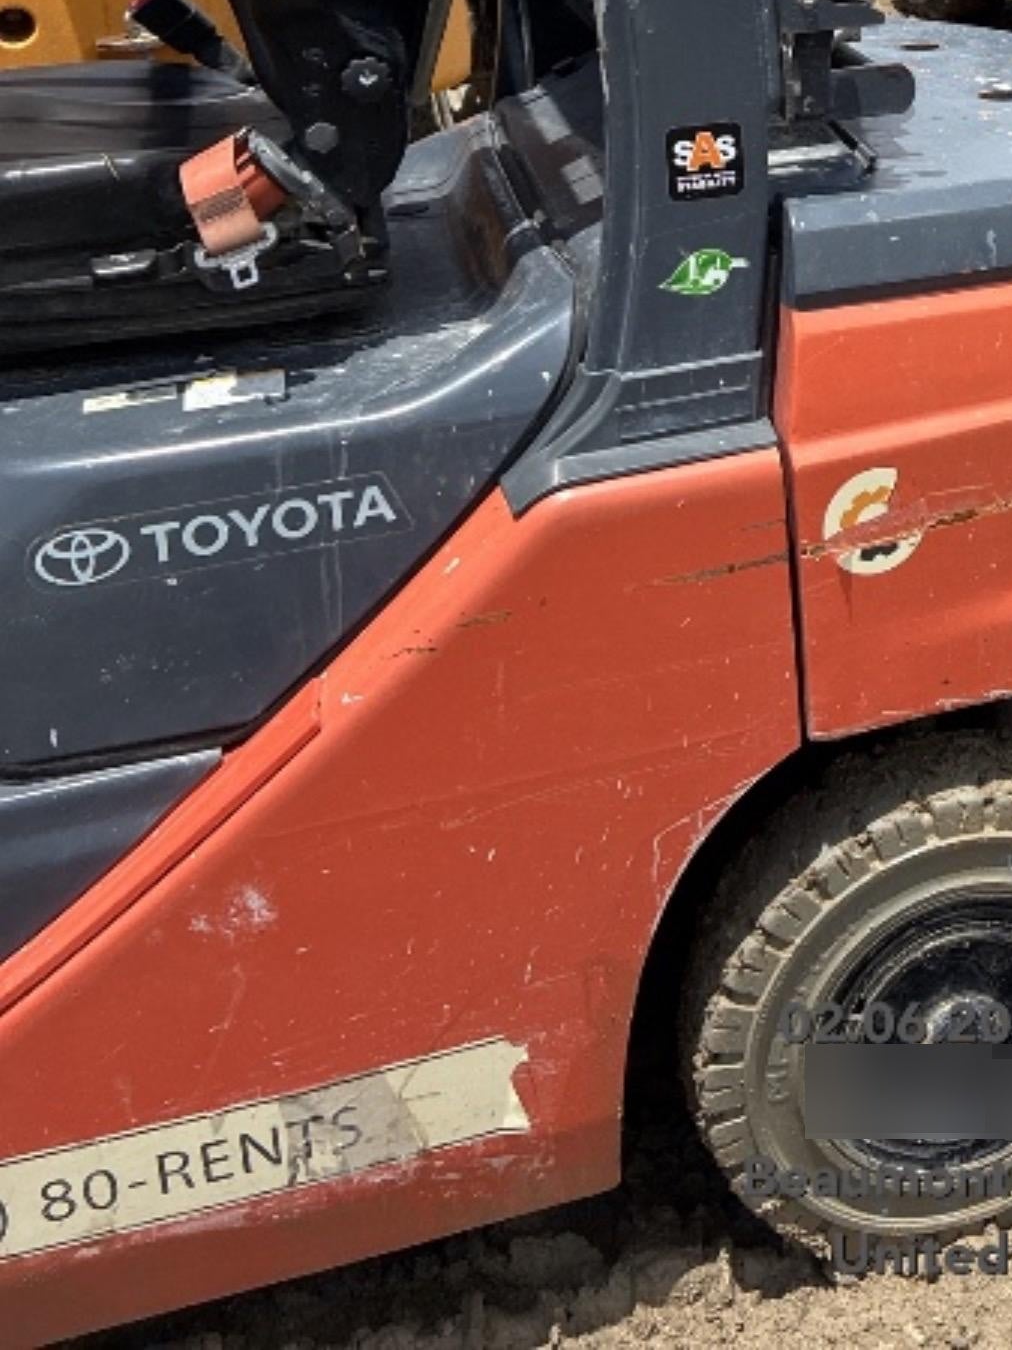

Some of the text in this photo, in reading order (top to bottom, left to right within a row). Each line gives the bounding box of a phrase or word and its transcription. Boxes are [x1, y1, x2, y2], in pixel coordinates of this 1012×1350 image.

[673, 131, 736, 171] SAS
[140, 485, 397, 562] TOYOTA
[40, 1105, 362, 1222] 80-RENTS
